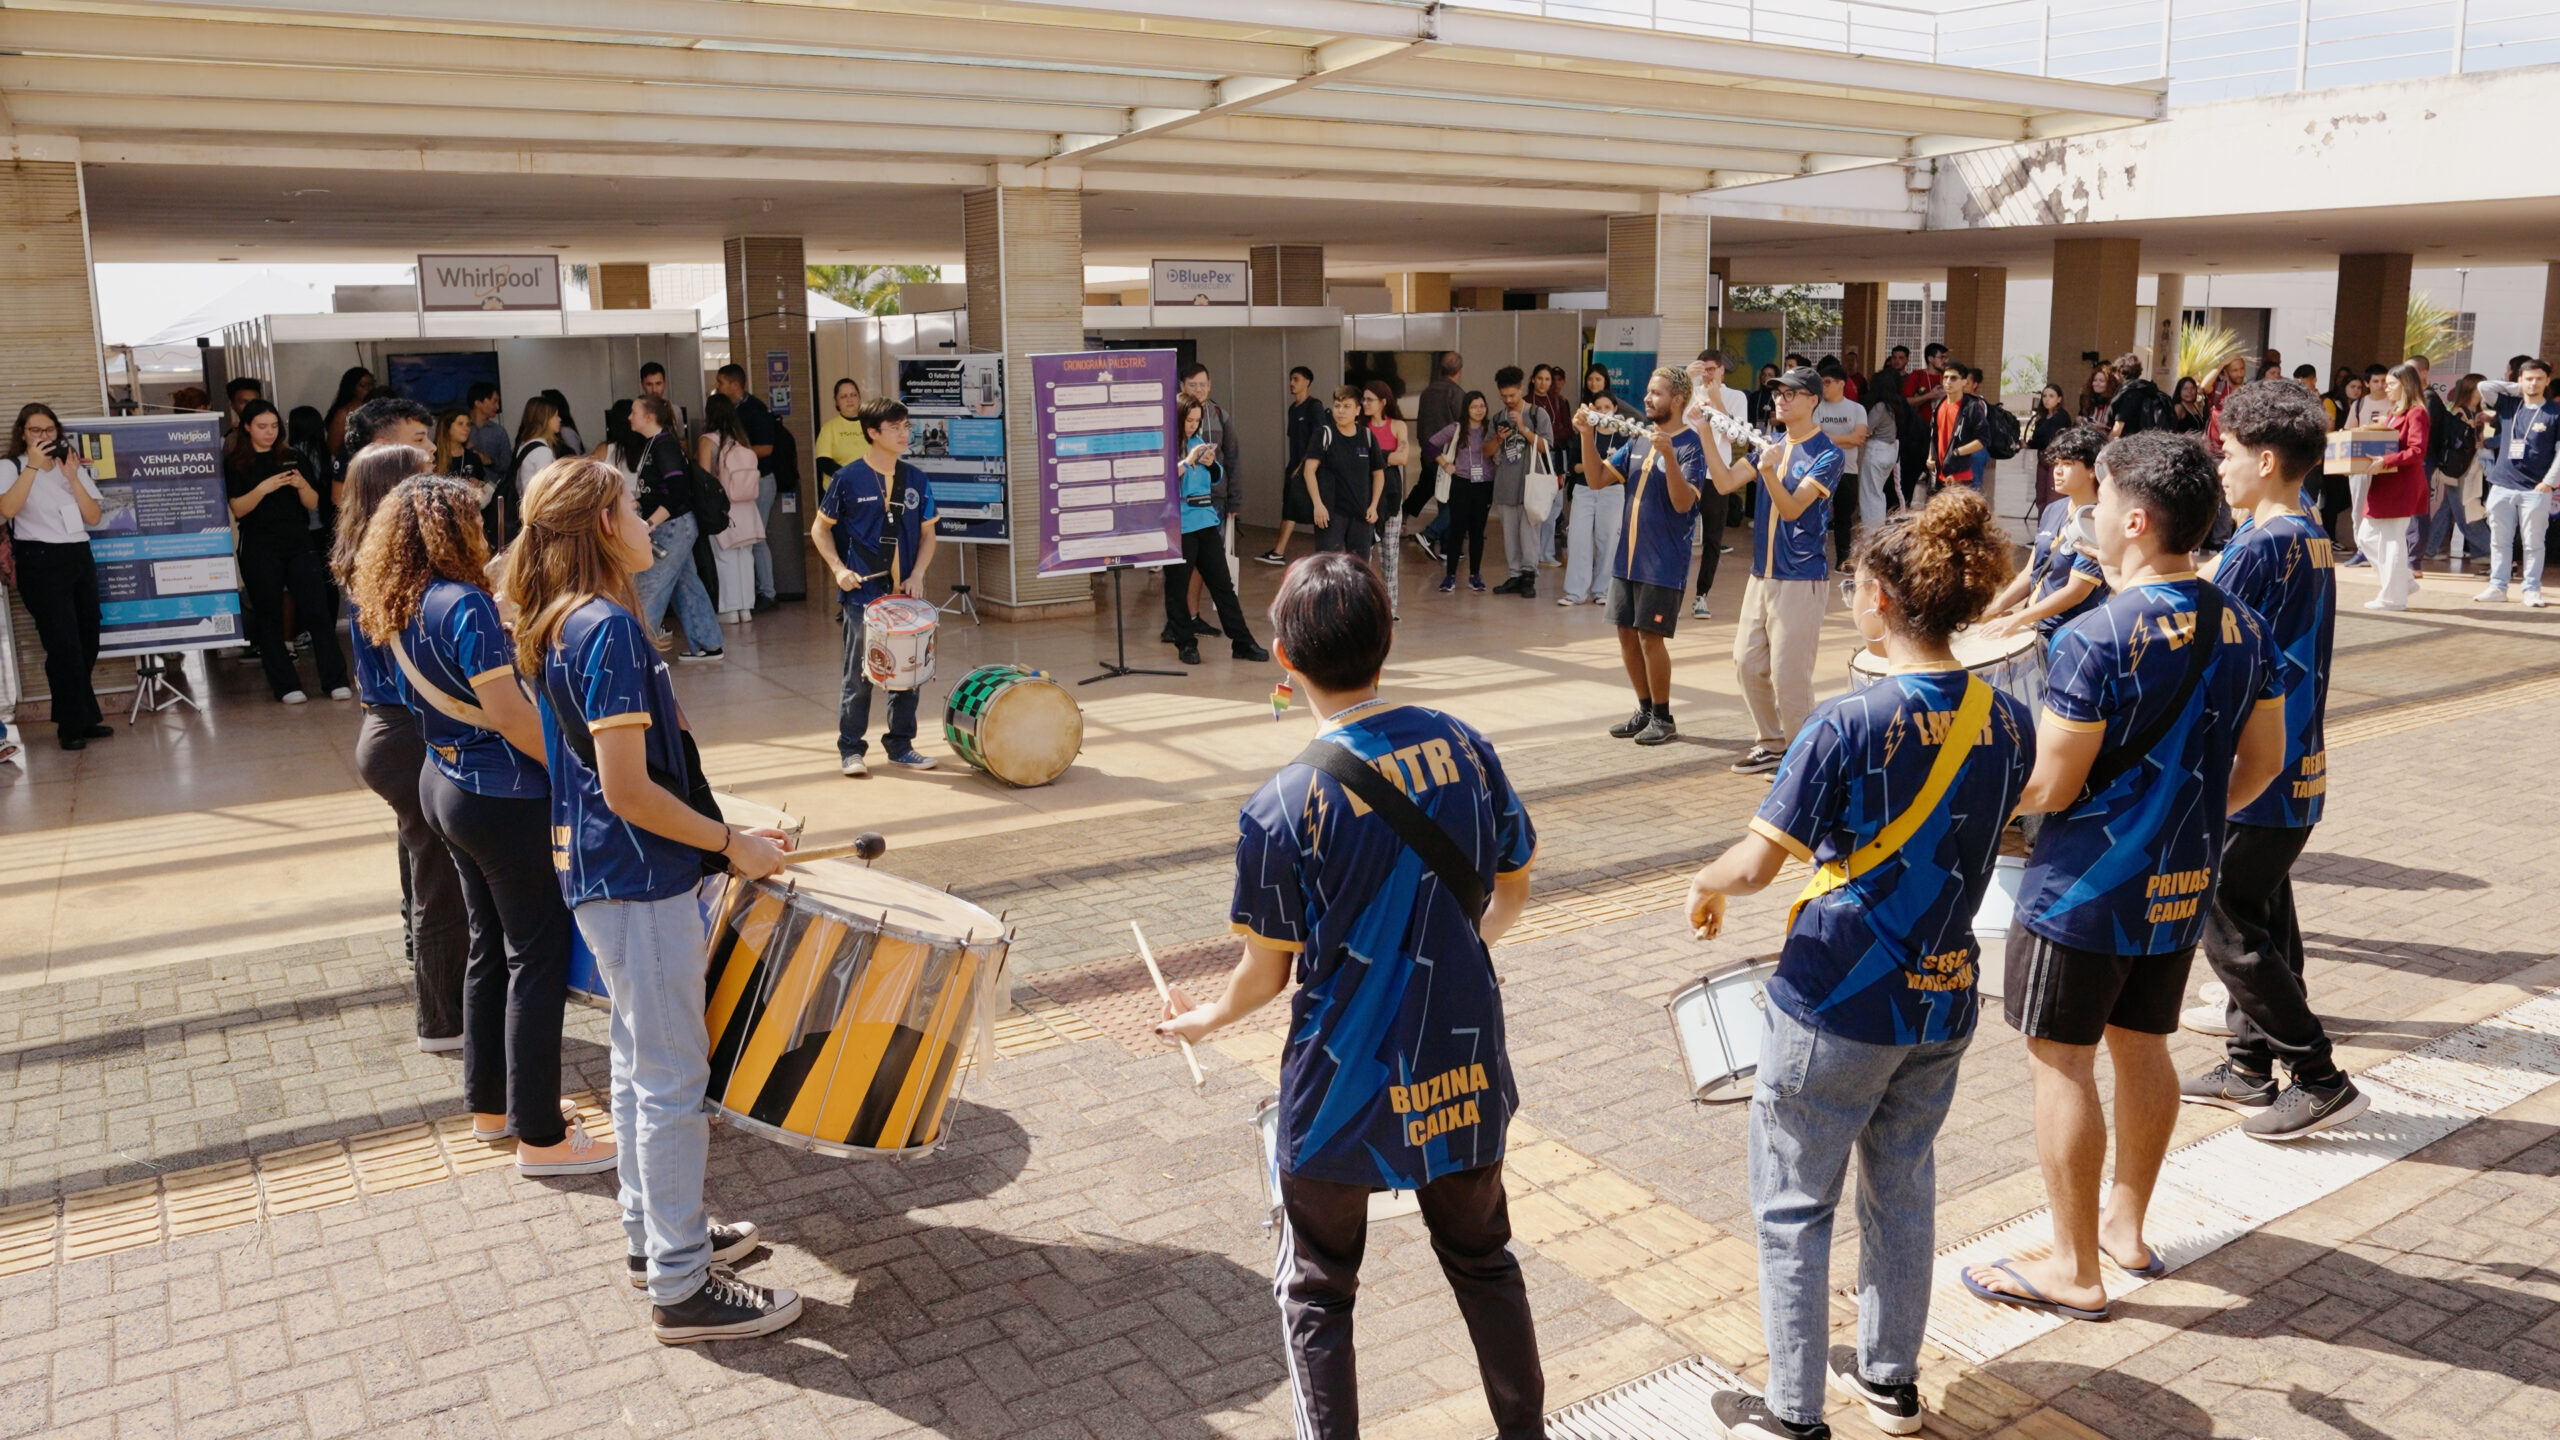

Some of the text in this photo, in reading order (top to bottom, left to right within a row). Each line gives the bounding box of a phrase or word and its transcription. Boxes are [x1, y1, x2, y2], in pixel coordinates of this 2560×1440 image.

[437, 267, 540, 293] Whirlpool
[1179, 269, 1232, 283] BluePex
[1063, 357, 1147, 371] CRONOGRAMA PALESTRAS
[168, 431, 211, 443] Whirlpool
[132, 465, 215, 477] A WHIRLPOOL!
[140, 453, 214, 465] VENHA PARA
[2145, 867, 2211, 898] PRIVAS
[2148, 898, 2198, 924] CAIXA
[1922, 948, 1968, 973] SESC
[1389, 1063, 1490, 1114] BUZINA
[1408, 1100, 1481, 1147] CAIXA
